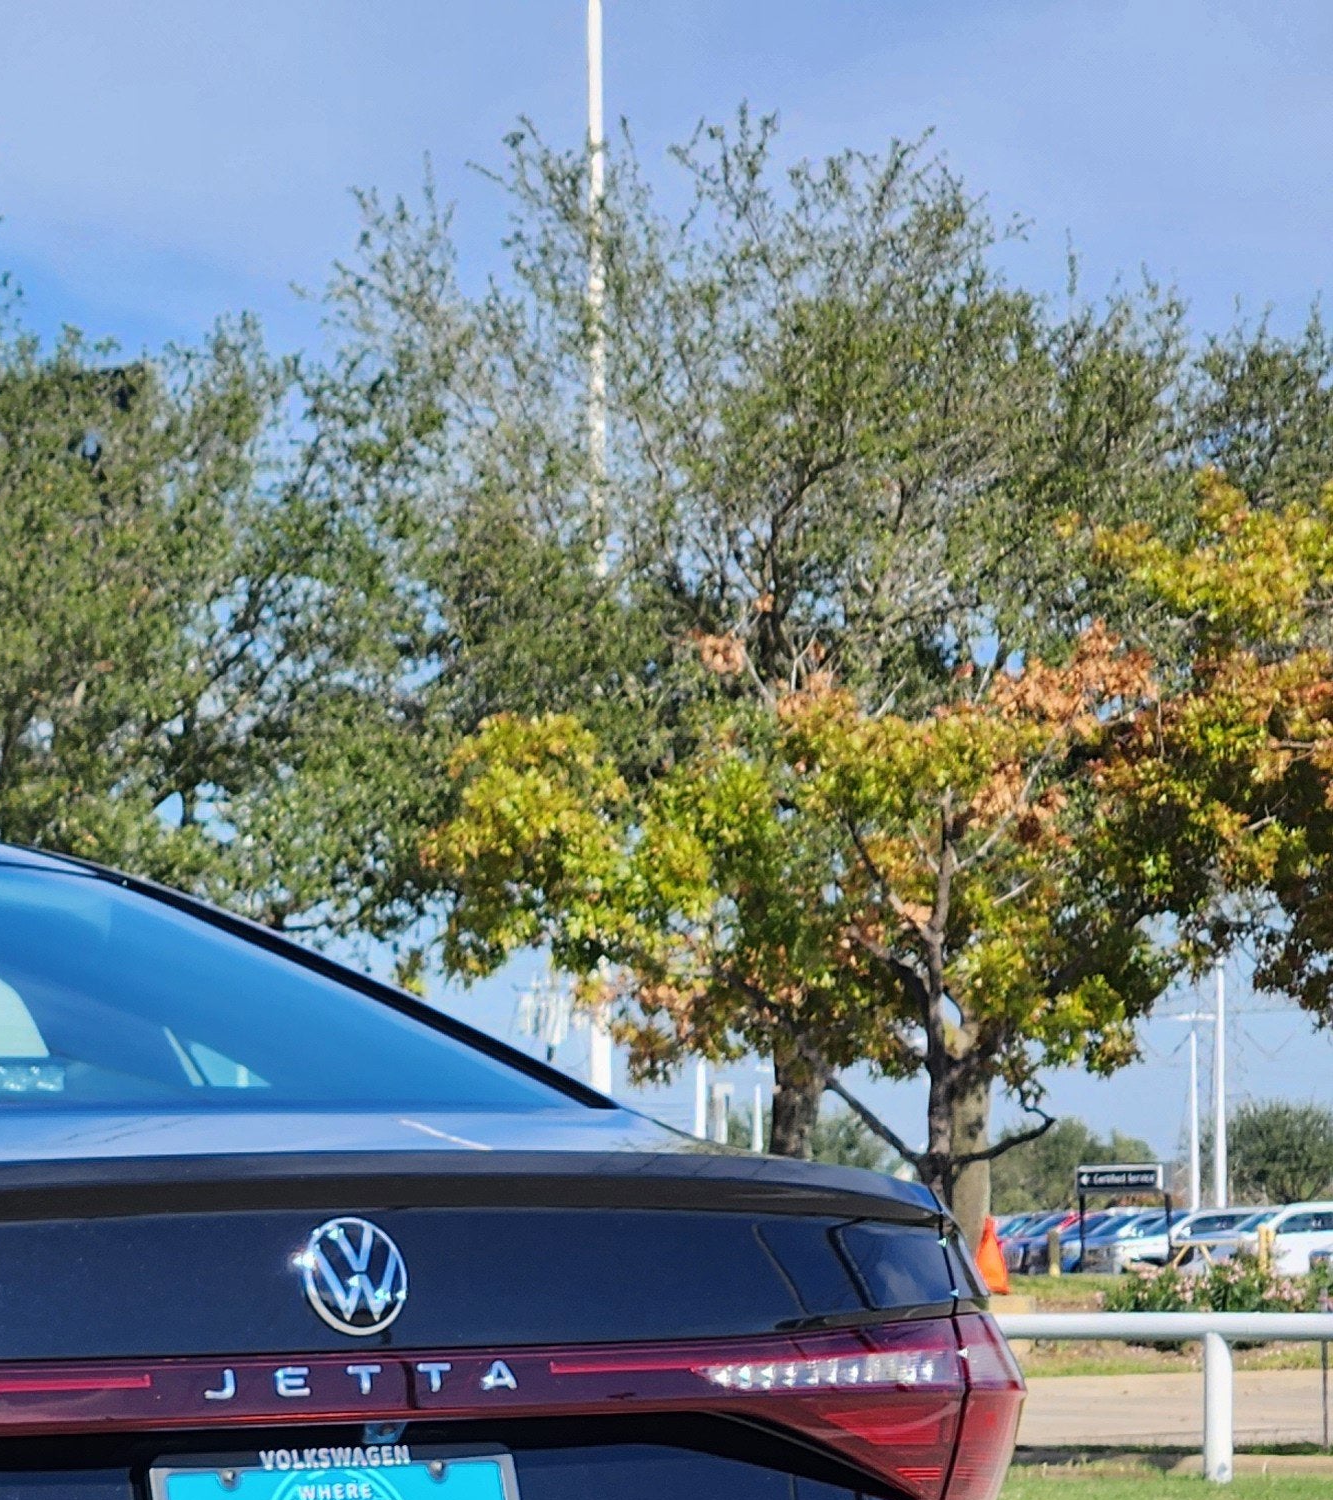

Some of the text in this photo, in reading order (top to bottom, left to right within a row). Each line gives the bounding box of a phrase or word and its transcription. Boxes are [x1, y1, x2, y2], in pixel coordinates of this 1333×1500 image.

[204, 1359, 518, 1400] JETTA
[259, 1445, 411, 1470] VOLKSWAGEN
[298, 1482, 373, 1500] WHERE
